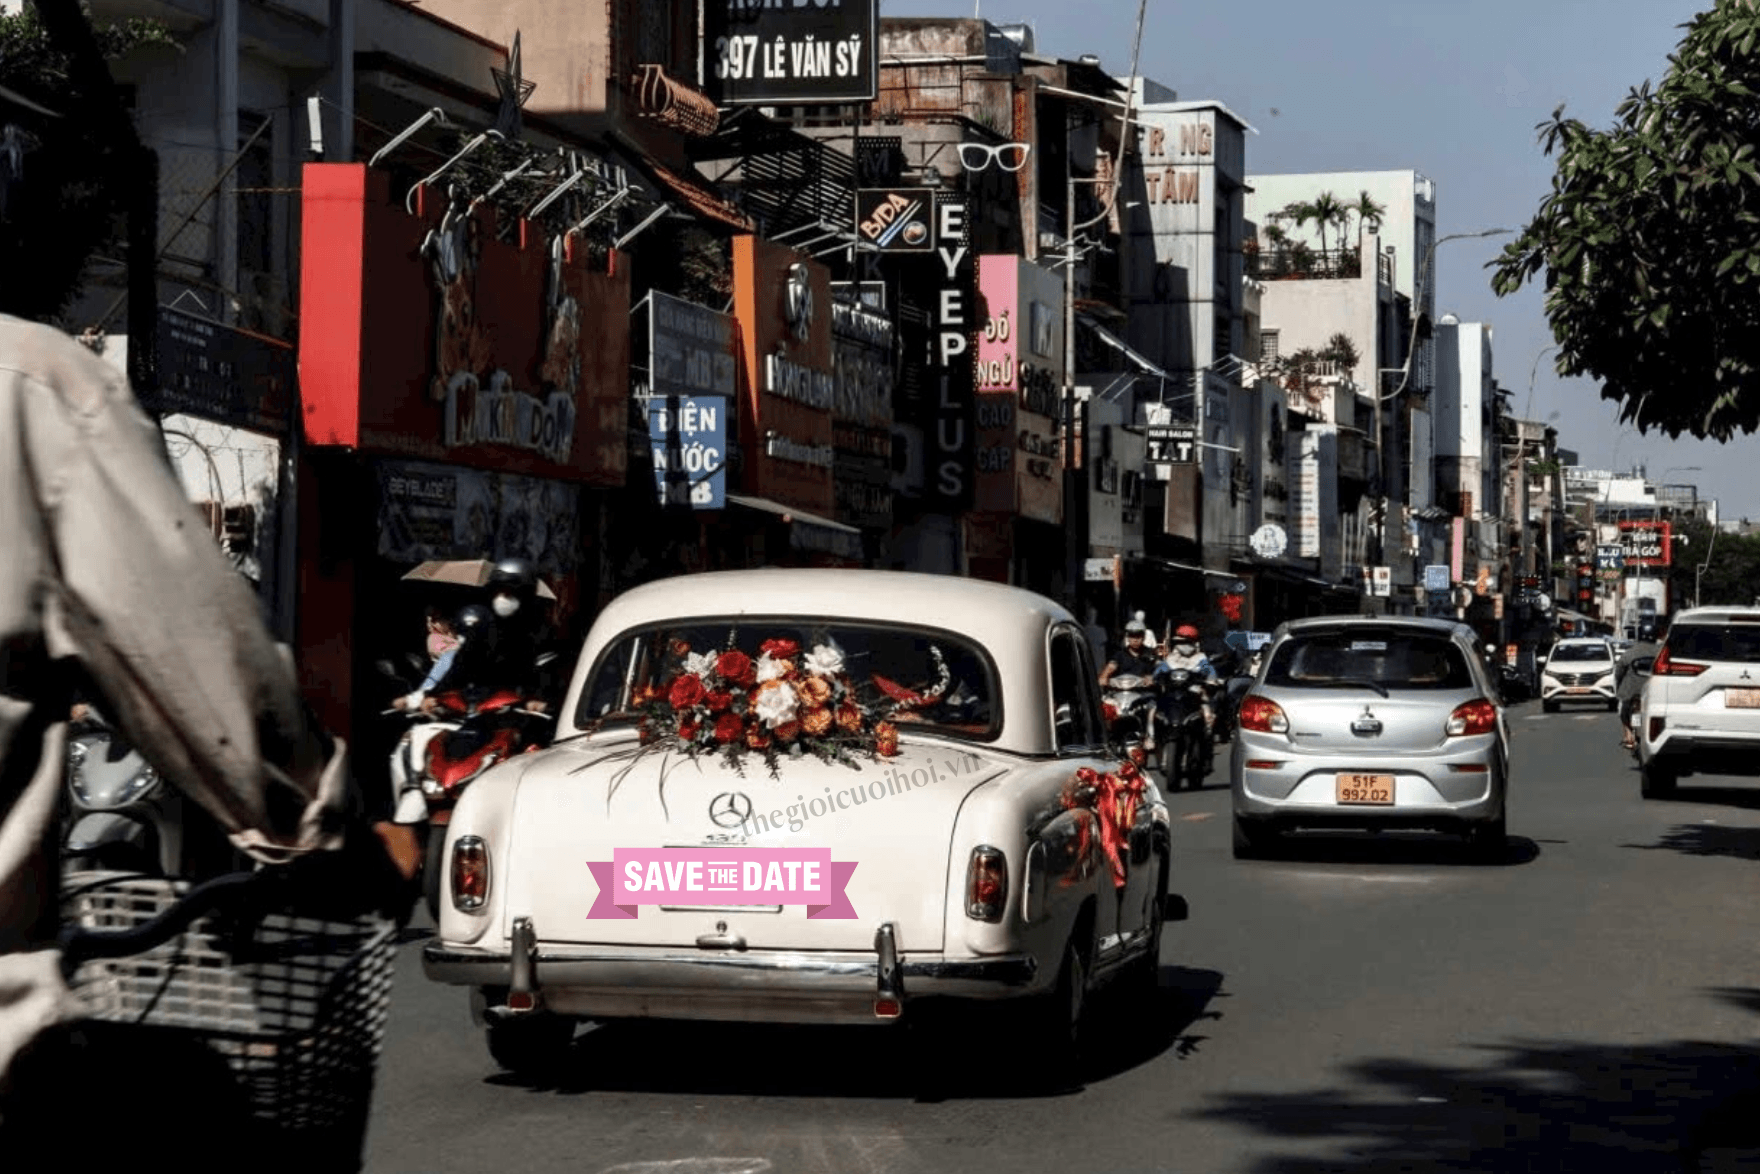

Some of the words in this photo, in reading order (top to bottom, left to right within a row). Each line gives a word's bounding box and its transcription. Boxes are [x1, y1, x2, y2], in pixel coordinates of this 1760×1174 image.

[714, 34, 759, 80] 397
[763, 34, 786, 79] LÊ
[790, 33, 831, 79] VĂN
[834, 33, 862, 78] SỸ
[1145, 167, 1199, 204] TÂM
[860, 193, 909, 239] BIDA
[1342, 788, 1389, 801] 992.02
[1352, 775, 1377, 788] 51F
